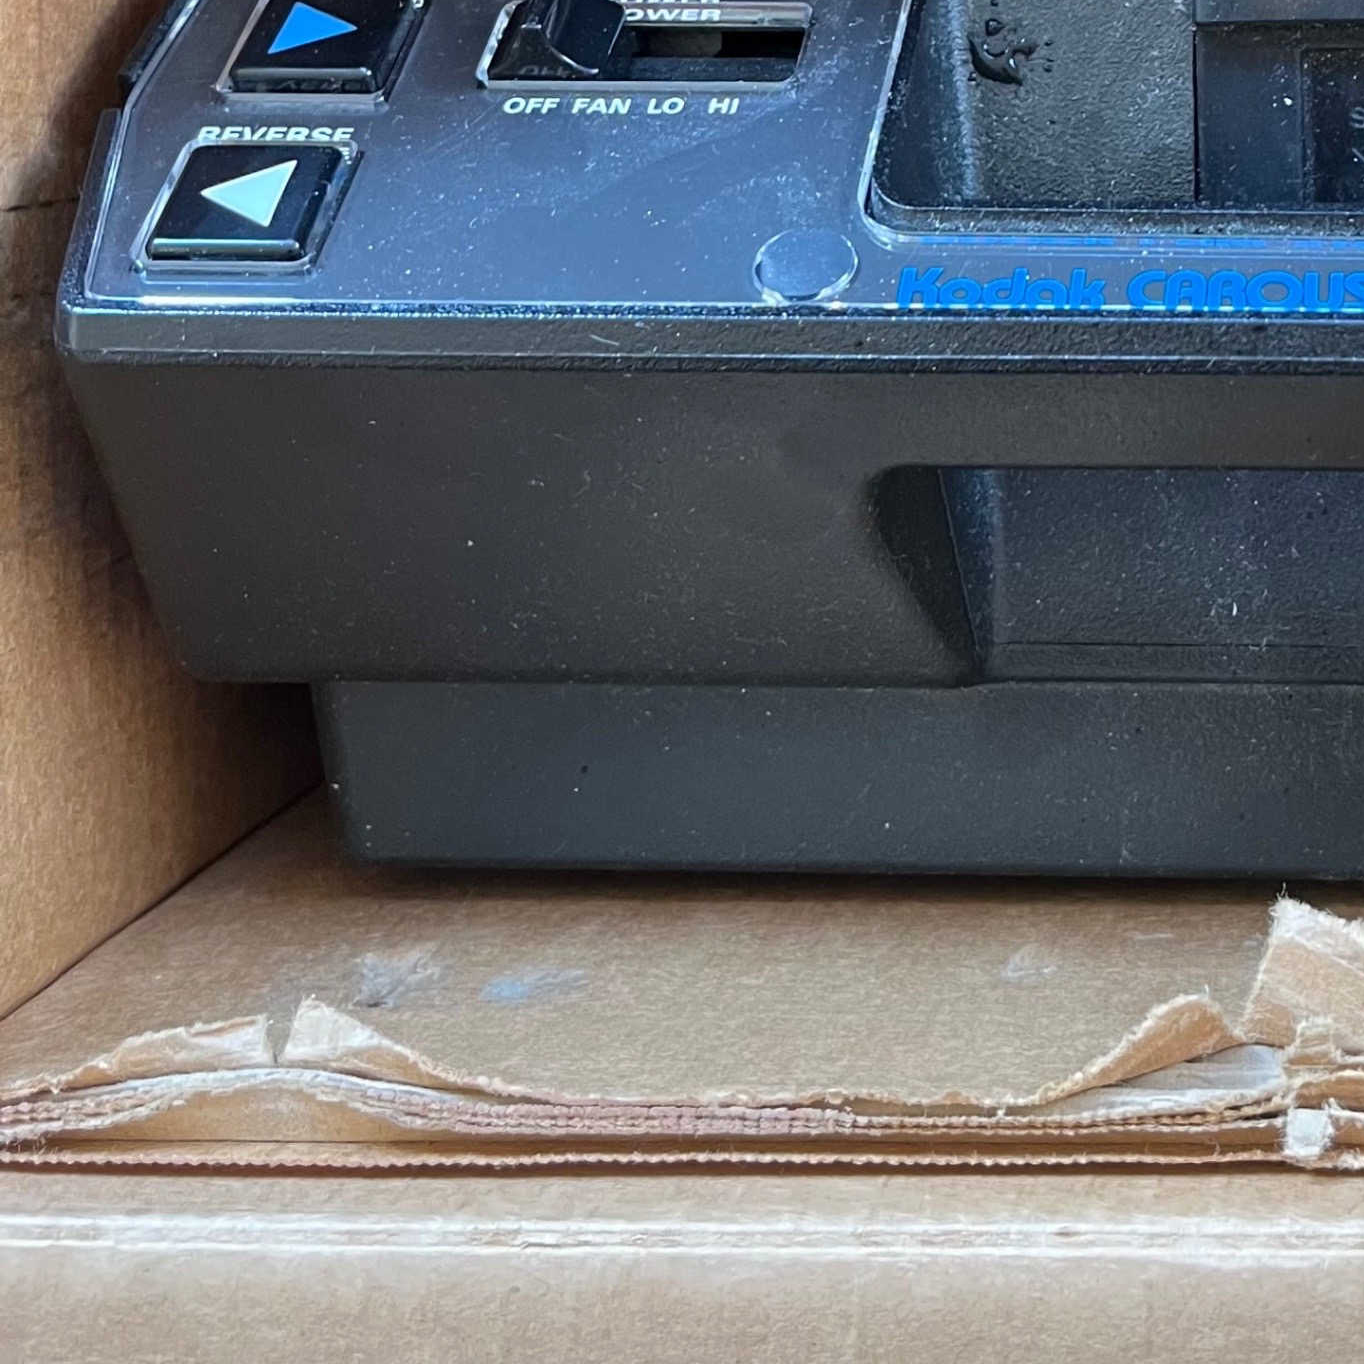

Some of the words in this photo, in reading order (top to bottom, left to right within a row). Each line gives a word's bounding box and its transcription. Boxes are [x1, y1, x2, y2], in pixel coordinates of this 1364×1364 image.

[502, 96, 561, 115] OFF
[570, 96, 633, 115] FAN
[645, 96, 686, 115] LO
[707, 96, 741, 115] HI
[197, 126, 355, 142] REVERSE
[897, 266, 1106, 311] Kodak
